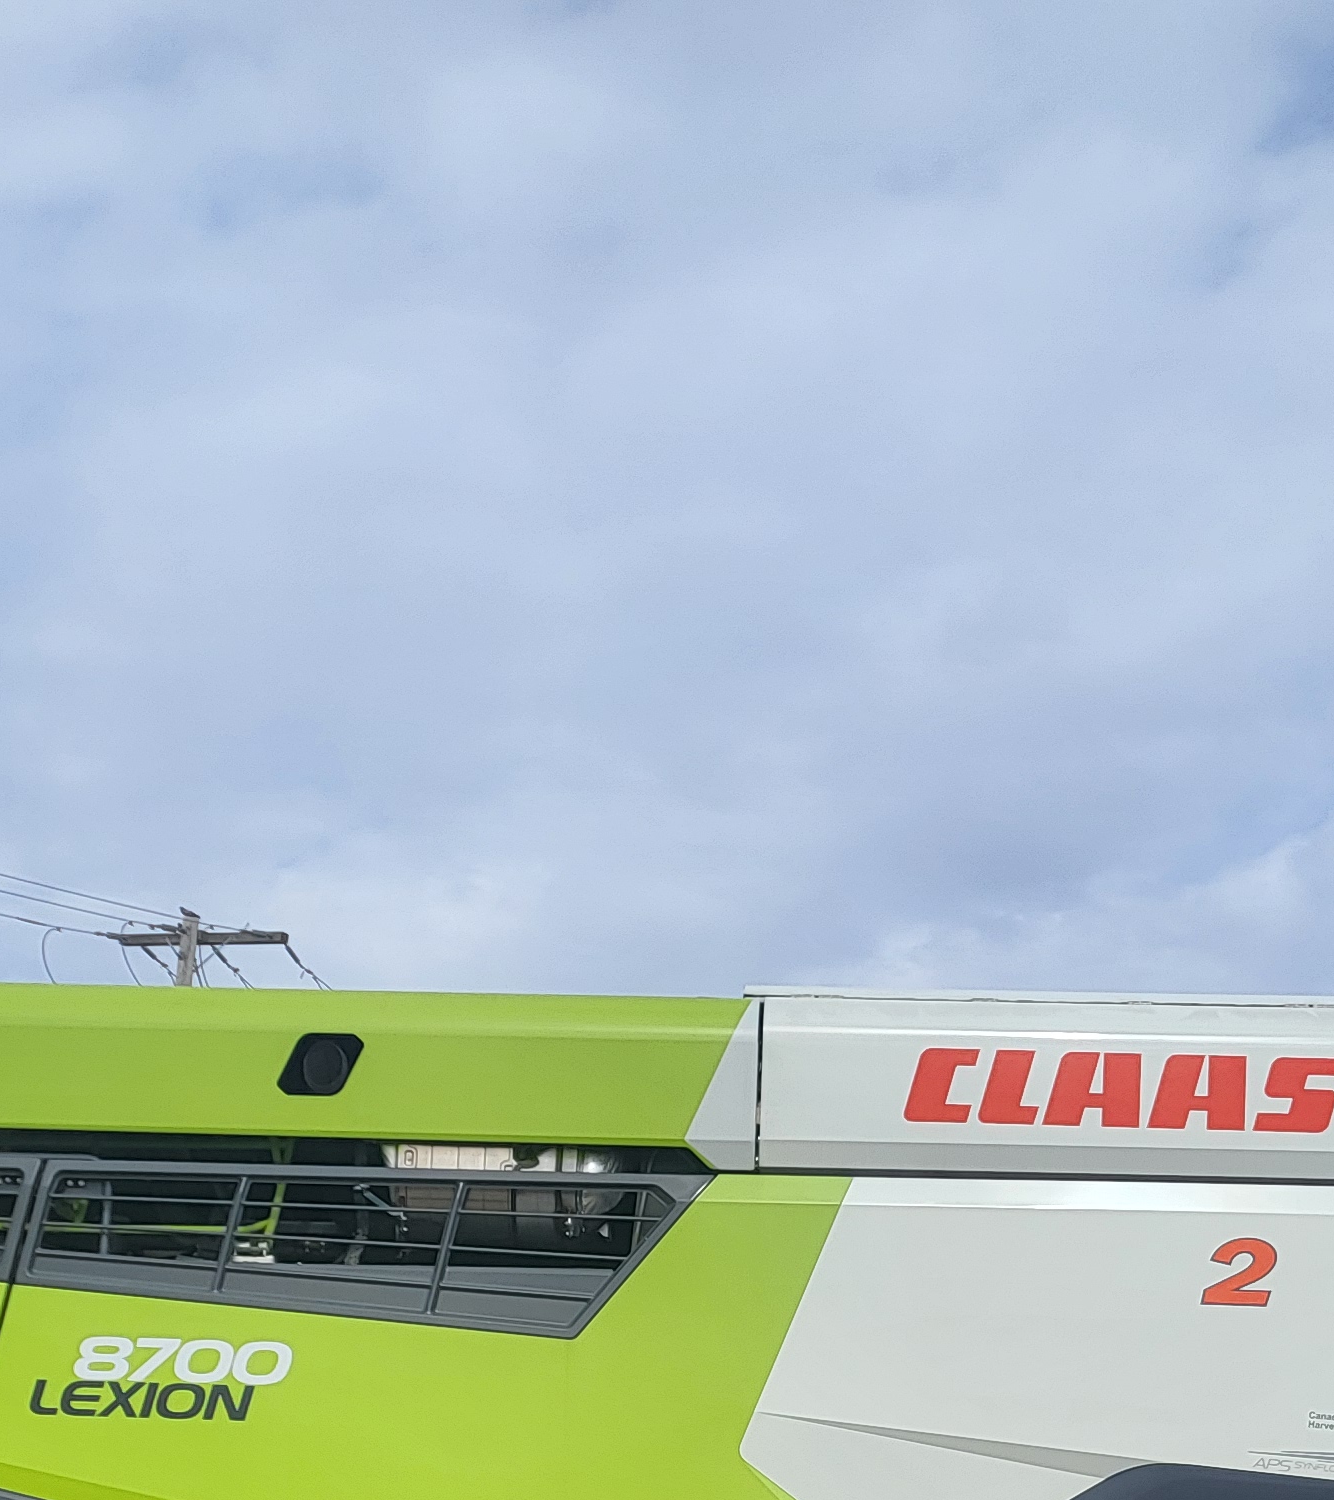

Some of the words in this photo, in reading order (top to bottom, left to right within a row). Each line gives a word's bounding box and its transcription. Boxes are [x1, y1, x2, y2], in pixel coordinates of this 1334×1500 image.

[1199, 1237, 1278, 1307] 2
[72, 1335, 293, 1385] 8700
[29, 1379, 255, 1421] LEXION
[1253, 1457, 1292, 1472] APS
